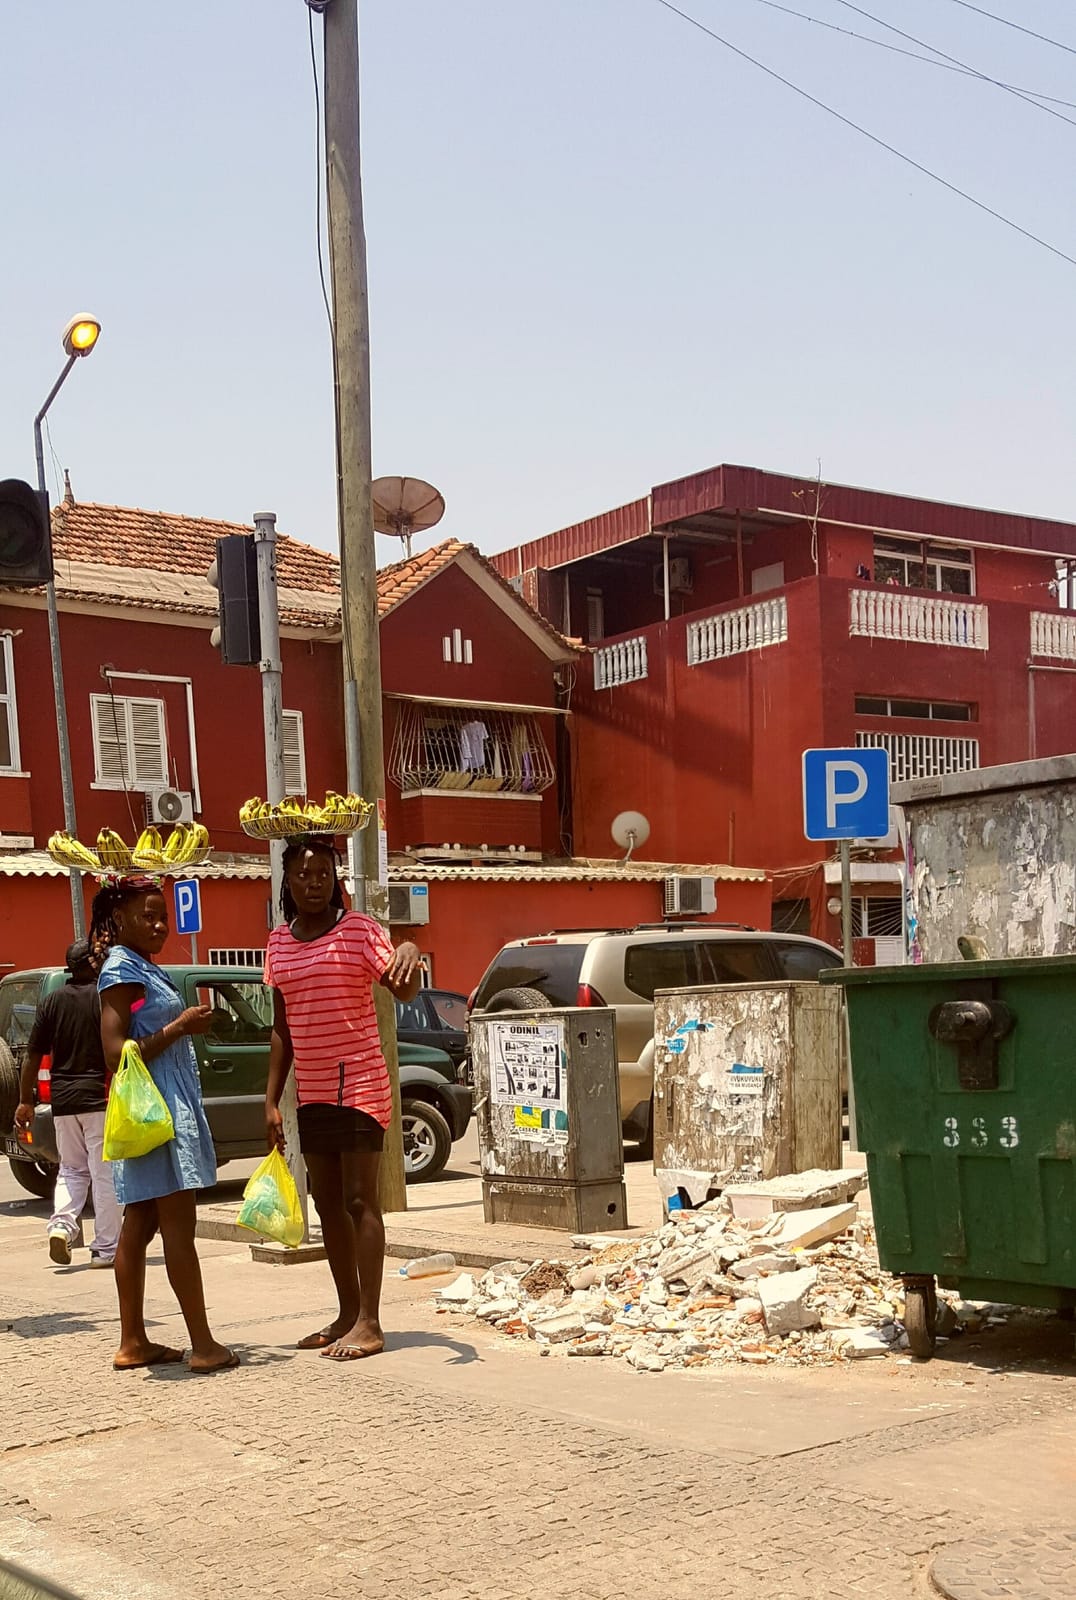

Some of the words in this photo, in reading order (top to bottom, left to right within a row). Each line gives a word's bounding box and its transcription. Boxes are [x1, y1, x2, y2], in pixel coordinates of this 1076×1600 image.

[825, 760, 868, 829] P
[178, 887, 193, 928] P
[510, 1026, 540, 1035] ODINIL
